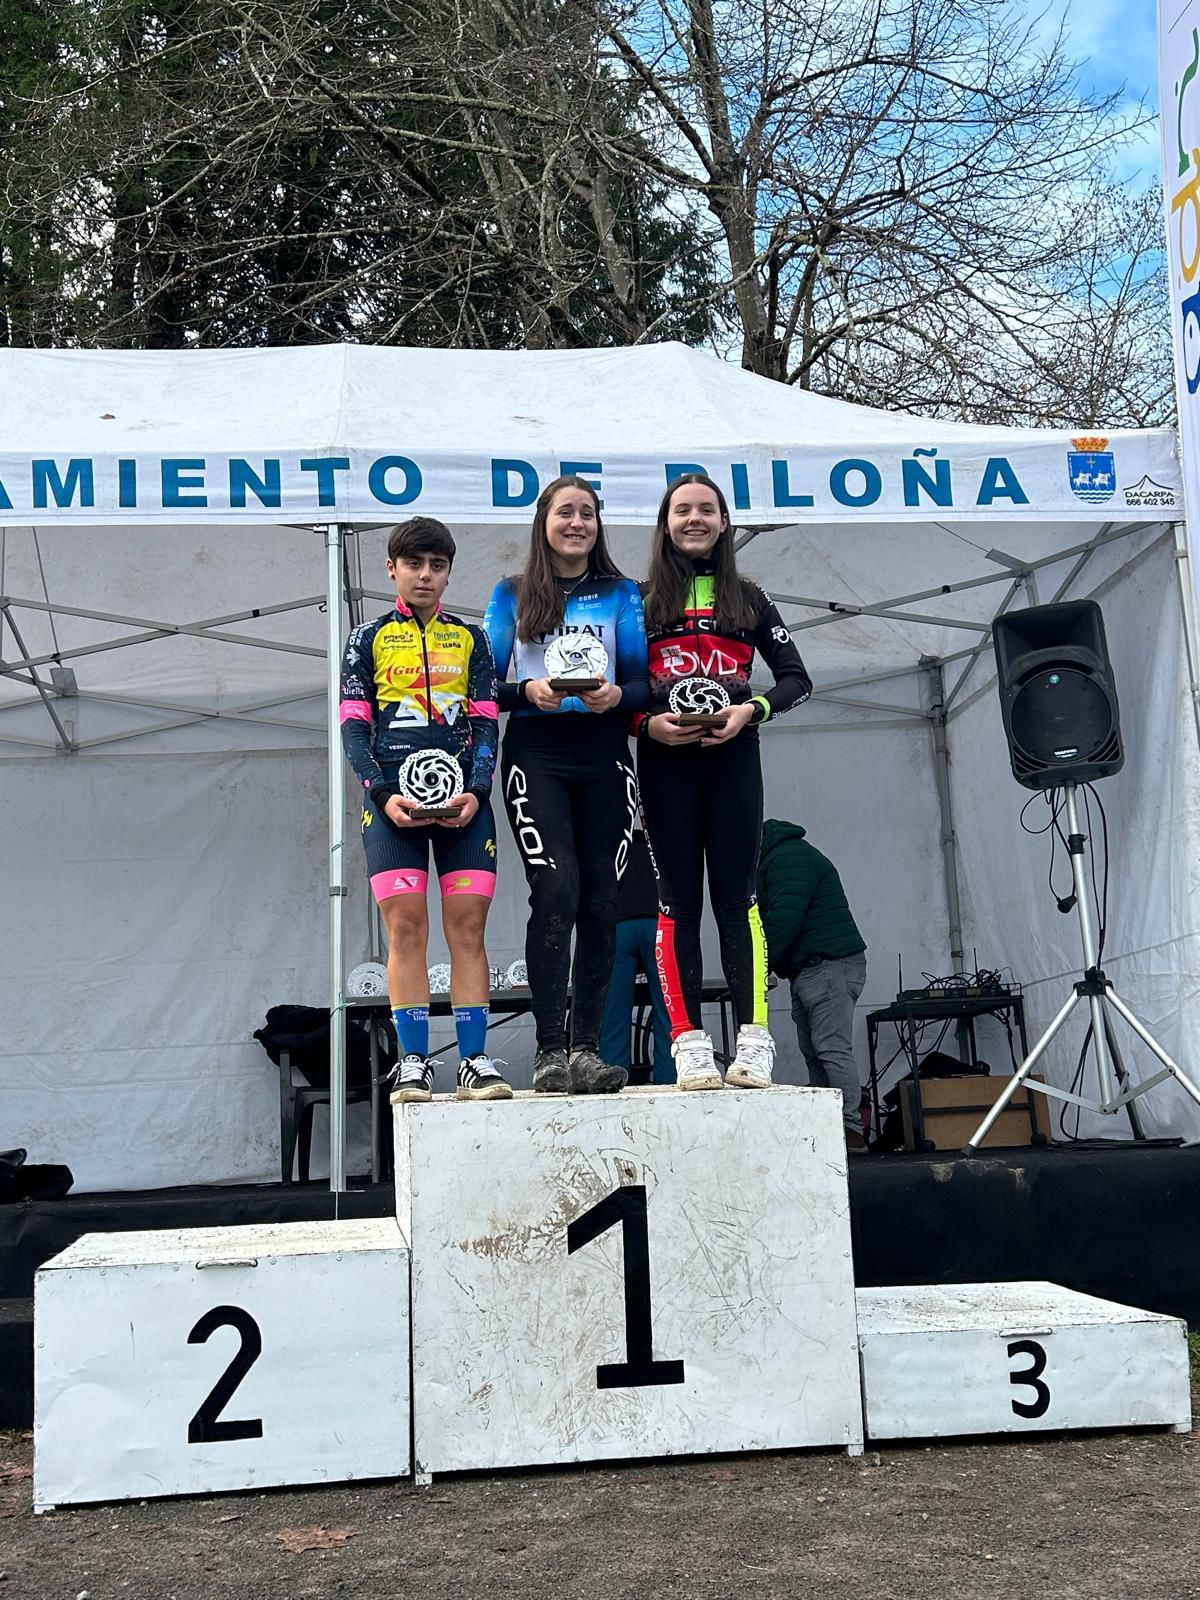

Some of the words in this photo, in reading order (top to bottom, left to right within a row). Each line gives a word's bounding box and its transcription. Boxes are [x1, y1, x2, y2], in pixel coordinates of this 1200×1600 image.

[0, 456, 424, 509] MIENTO
[655, 945, 672, 1007] OVIEDO
[568, 1185, 684, 1389] 1
[187, 1305, 263, 1443] 2
[1007, 1340, 1050, 1418] 3
